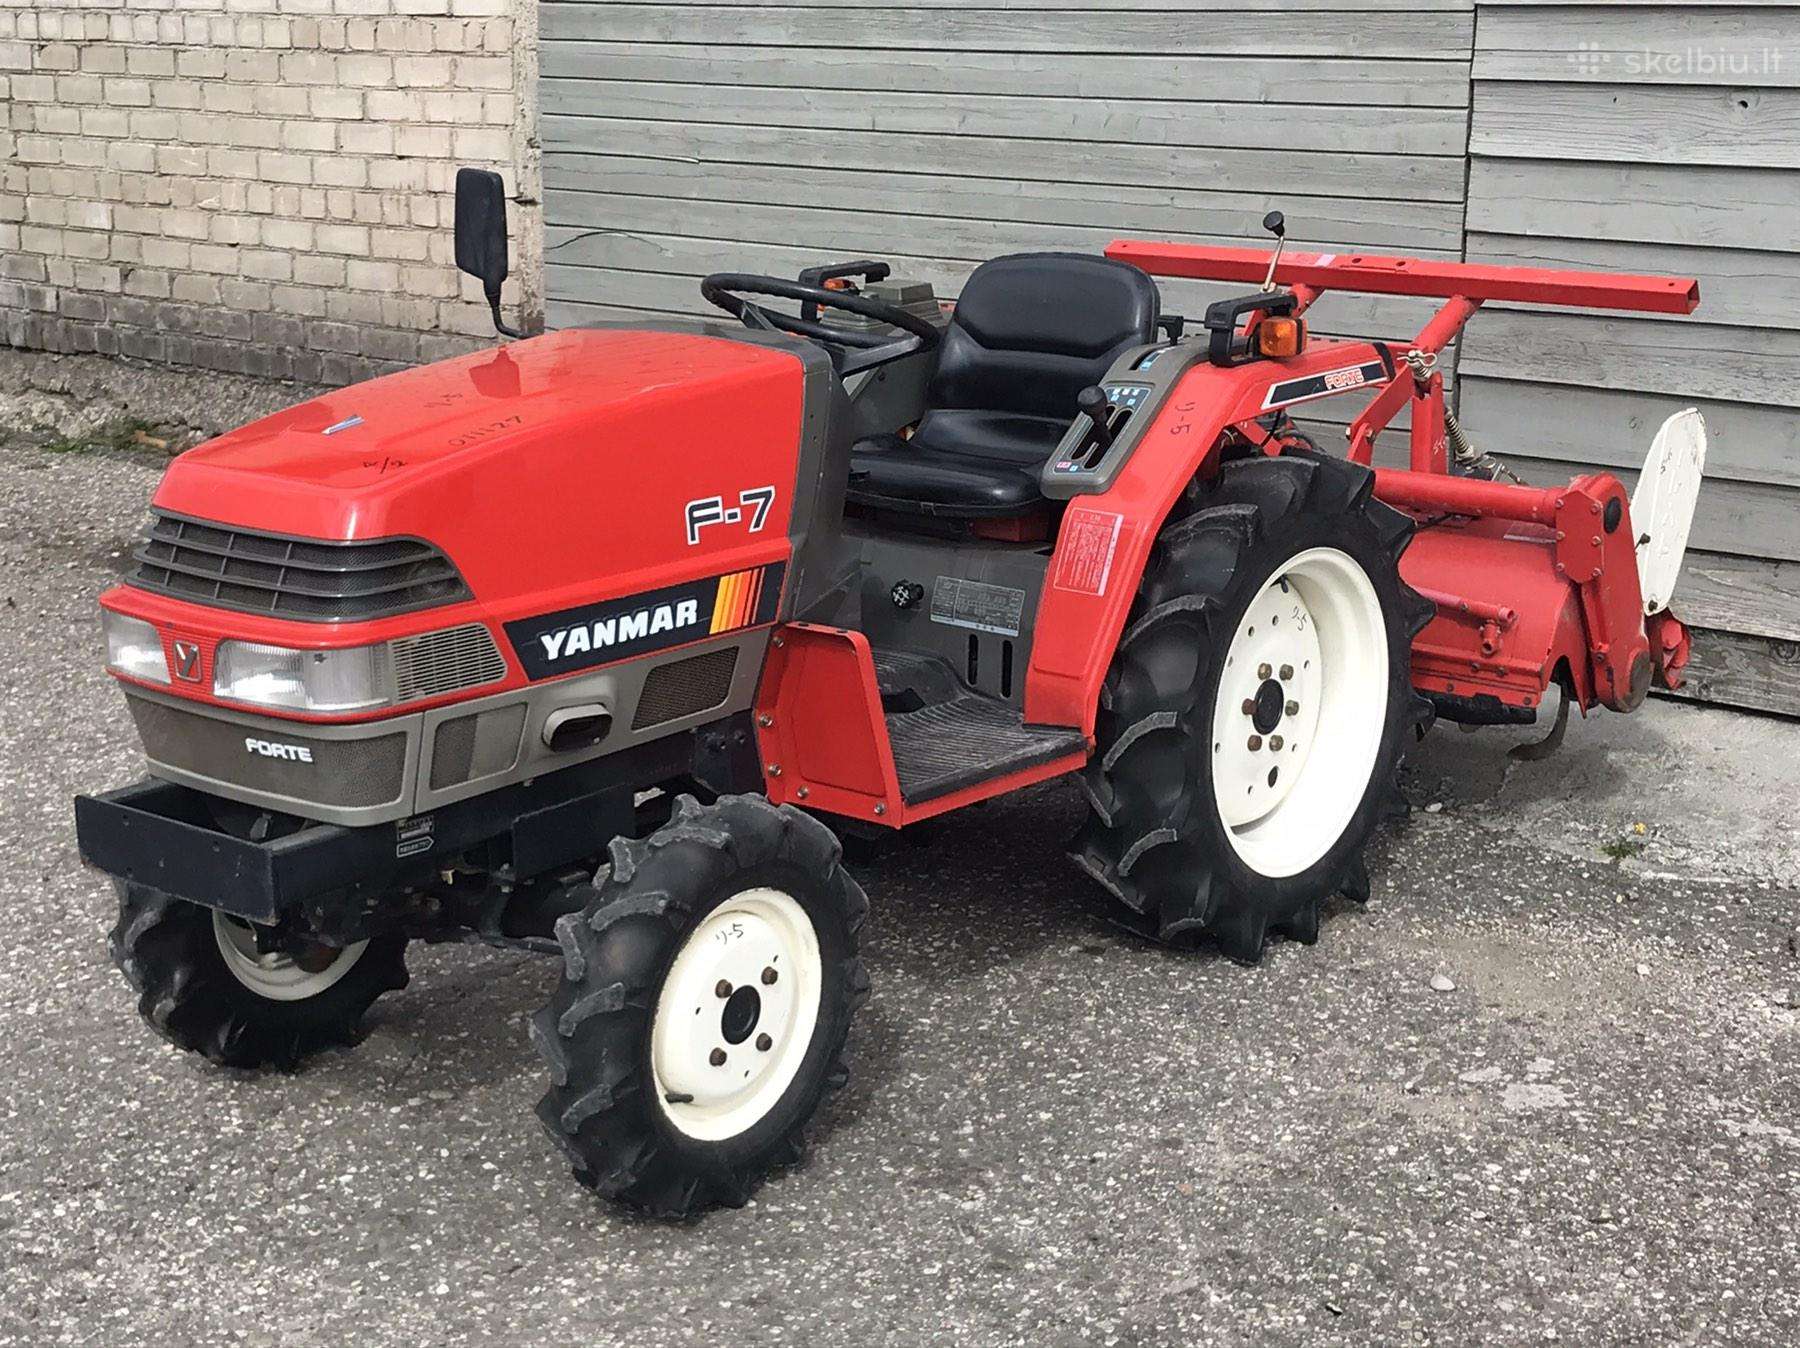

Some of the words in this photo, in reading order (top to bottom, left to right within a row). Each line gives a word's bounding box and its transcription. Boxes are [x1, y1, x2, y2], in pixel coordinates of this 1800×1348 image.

[1324, 367, 1365, 390] FORTE
[685, 485, 775, 545] F-7
[540, 599, 698, 661] YANMAR
[244, 737, 314, 763] FORTE
